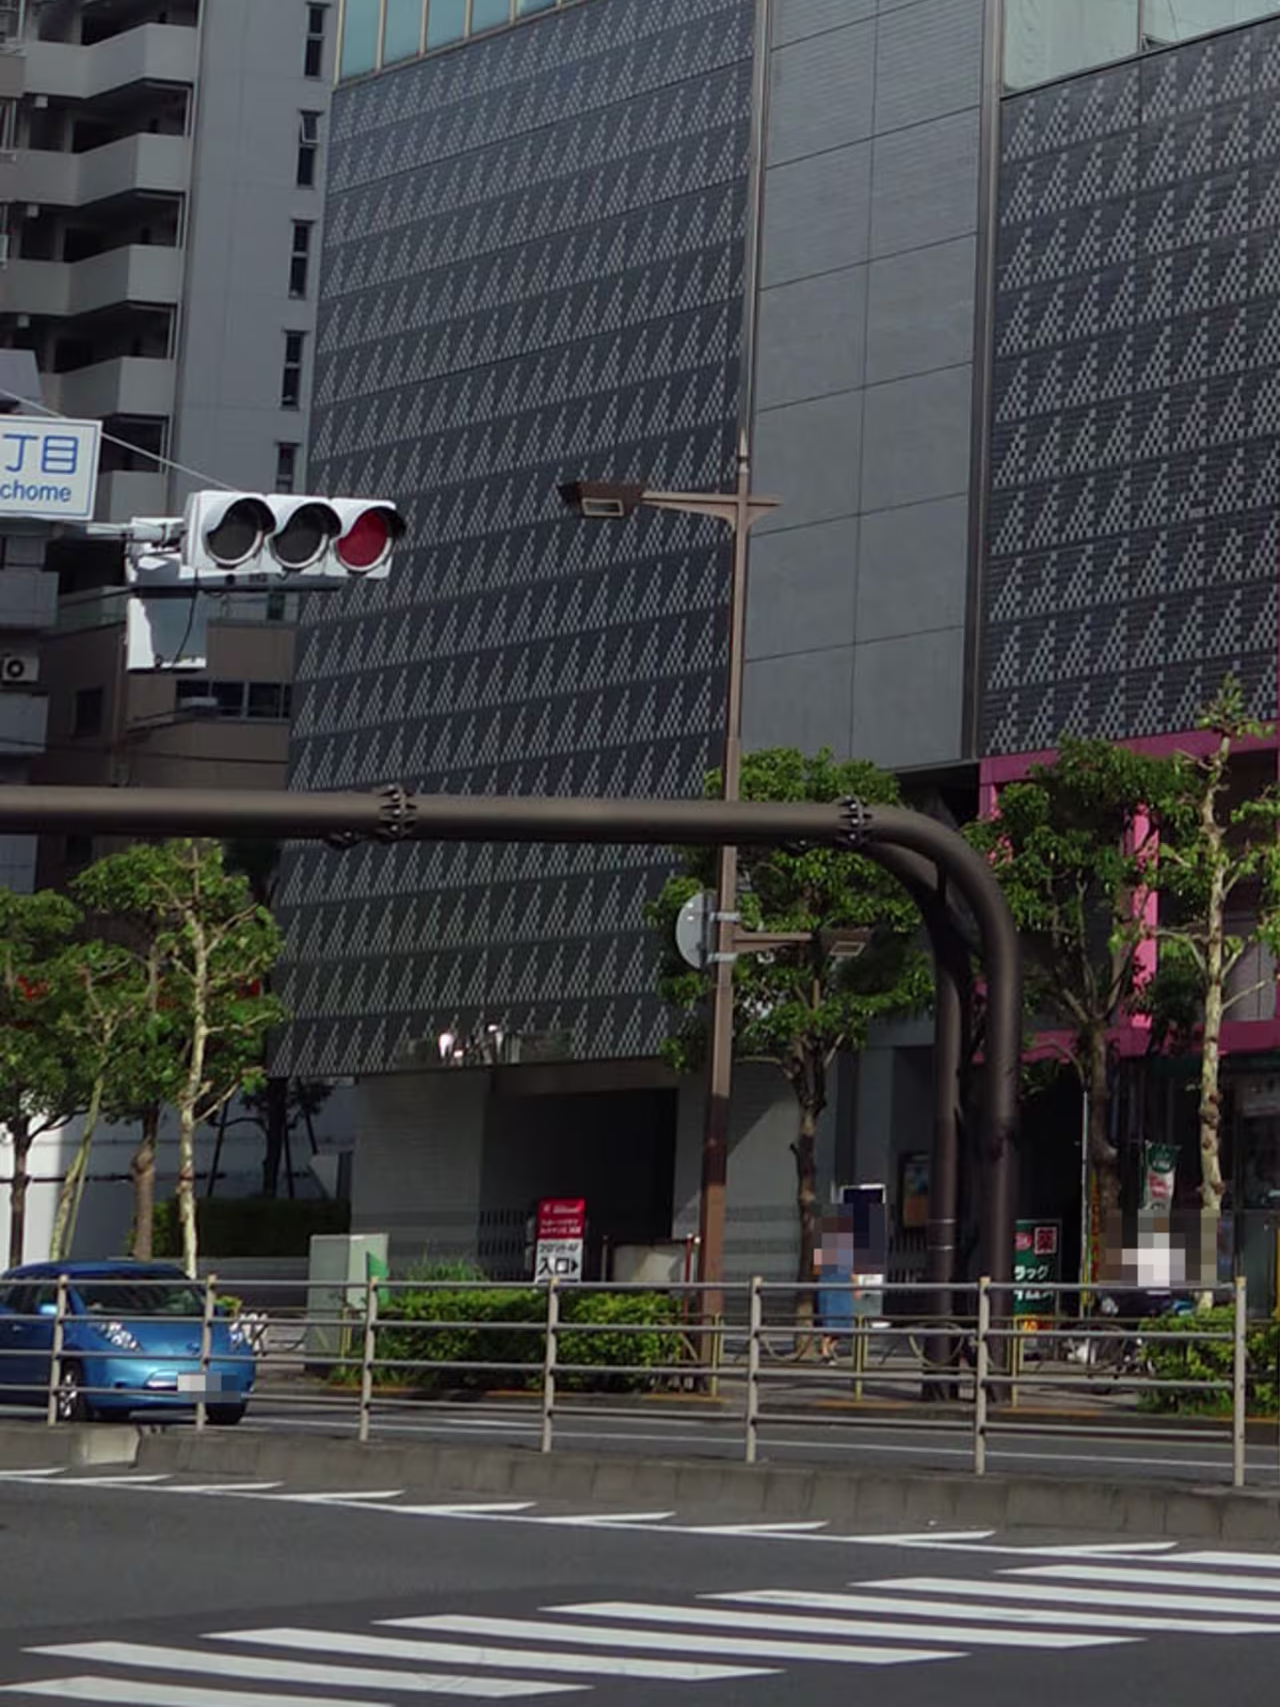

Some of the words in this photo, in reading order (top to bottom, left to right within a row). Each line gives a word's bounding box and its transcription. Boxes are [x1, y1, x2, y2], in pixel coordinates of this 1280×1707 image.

[2, 433, 79, 475] 丁目
[0, 479, 72, 503] chome
[538, 1257, 570, 1276] 入口
